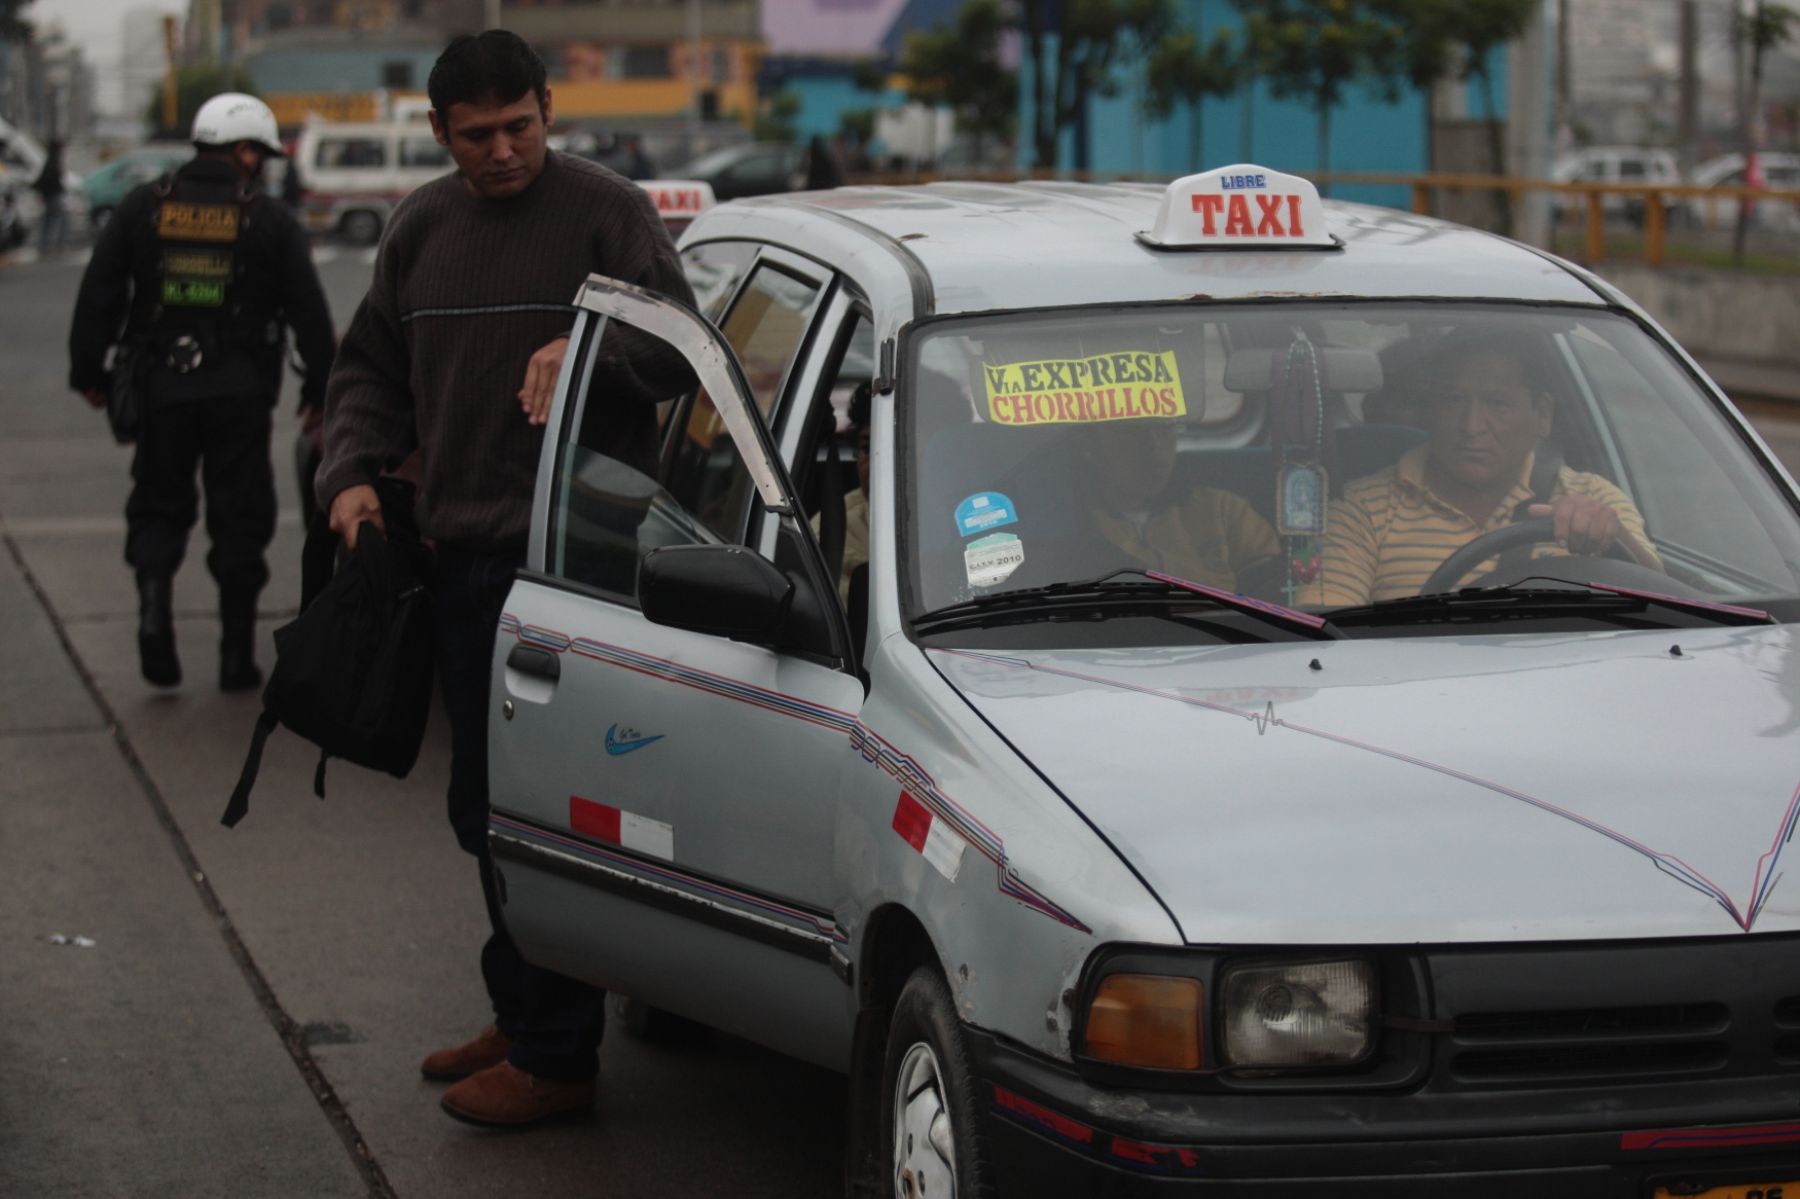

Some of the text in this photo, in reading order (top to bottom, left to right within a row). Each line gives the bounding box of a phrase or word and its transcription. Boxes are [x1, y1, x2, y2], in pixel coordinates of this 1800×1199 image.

[1221, 175, 1265, 189] LIBRE
[165, 205, 235, 226] POLICIA
[1191, 194, 1304, 237] TAXI
[986, 354, 1174, 395] VIA EXPRESA
[992, 387, 1178, 424] CHORRILLOS
[997, 554, 1021, 565] 2010
